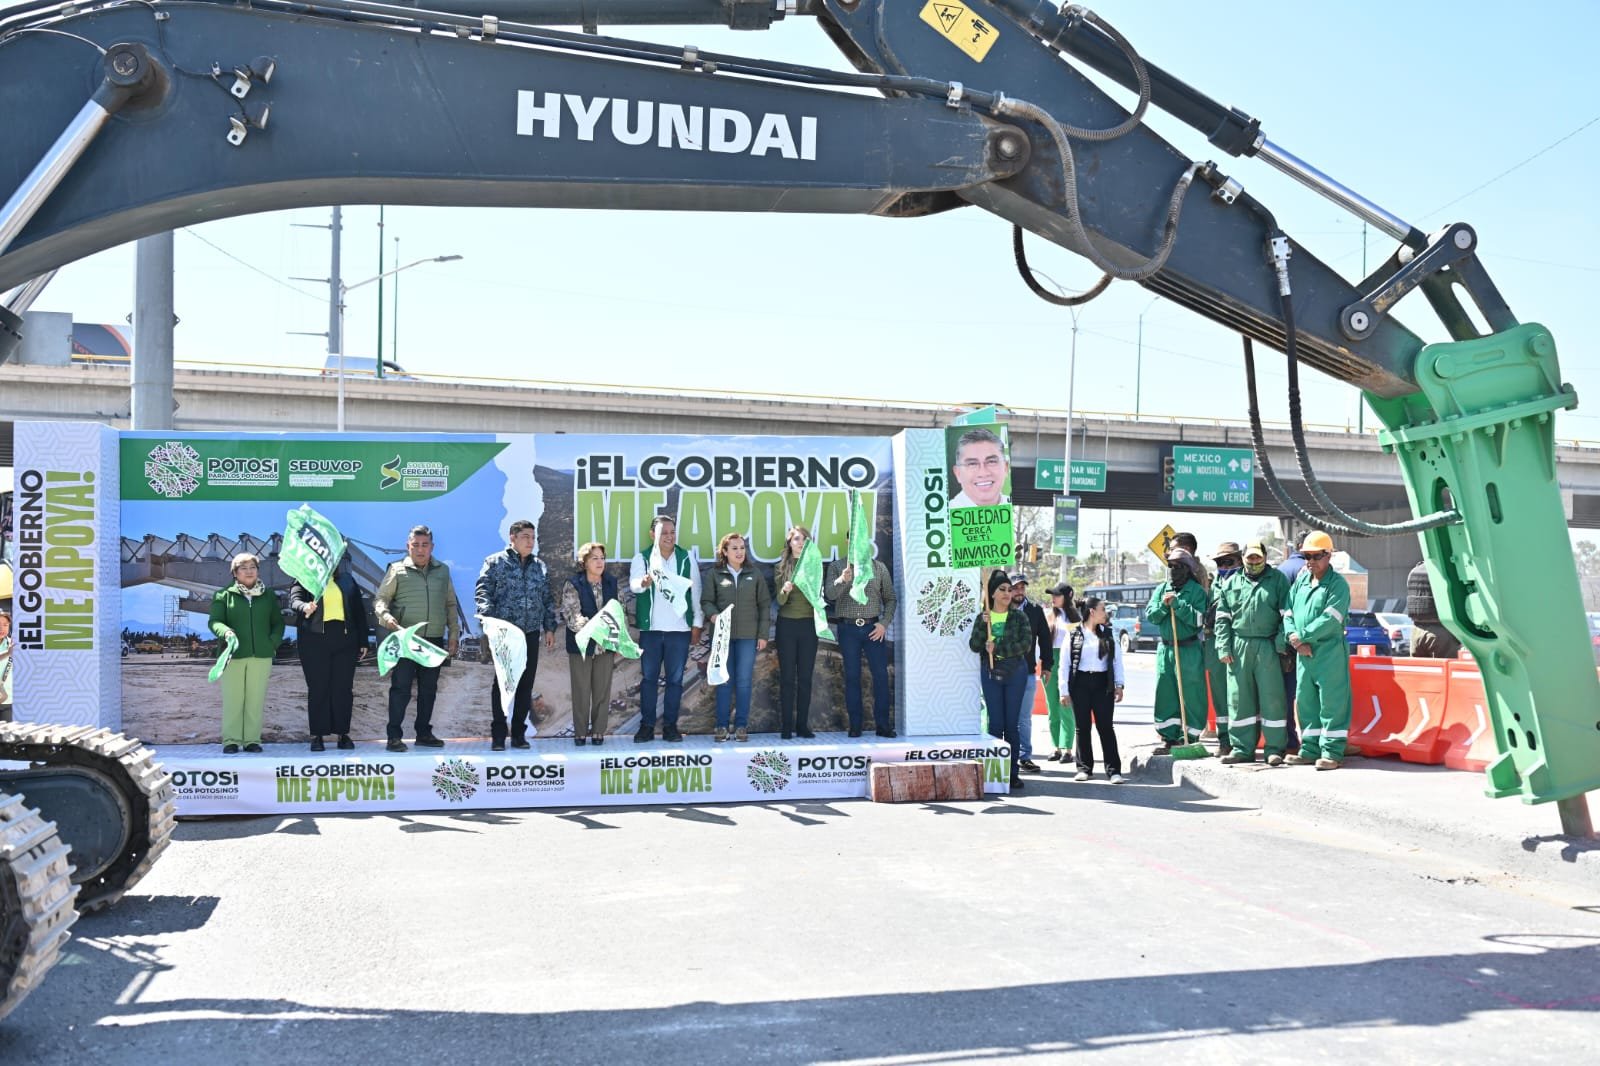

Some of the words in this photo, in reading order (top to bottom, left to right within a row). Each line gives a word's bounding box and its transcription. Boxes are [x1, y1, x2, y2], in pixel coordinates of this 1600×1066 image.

[516, 89, 818, 161] HYUNDAI
[1183, 453, 1221, 464] MEXICO
[290, 461, 362, 472] SEDUVOP
[577, 456, 635, 489] ¡EL
[640, 455, 877, 488] GOBIERNO
[1053, 465, 1084, 474] BULVAR
[1177, 465, 1192, 474] ZONA
[1196, 466, 1227, 476] INDUSTRIAL
[1202, 491, 1217, 502] RIO
[1222, 492, 1250, 503] VERDE
[951, 508, 1010, 527] SOLEDAD
[45, 471, 95, 592] APOYA!
[962, 526, 992, 535] CERCA
[19, 469, 43, 613] GOBIERNO
[954, 543, 1011, 560] NAVARRO
[44, 598, 94, 650] ME
[905, 750, 926, 760] ¡EL
[927, 746, 1011, 760] GOBIERNO
[600, 758, 623, 769] ¡EL
[624, 755, 713, 768] GOBIERNO
[276, 765, 299, 777] ¡EL
[300, 763, 395, 777] GOBIERNO
[600, 768, 633, 794] ME
[637, 767, 712, 793] APOYA!
[277, 778, 312, 802] ME
[315, 776, 395, 802] APOYA!
